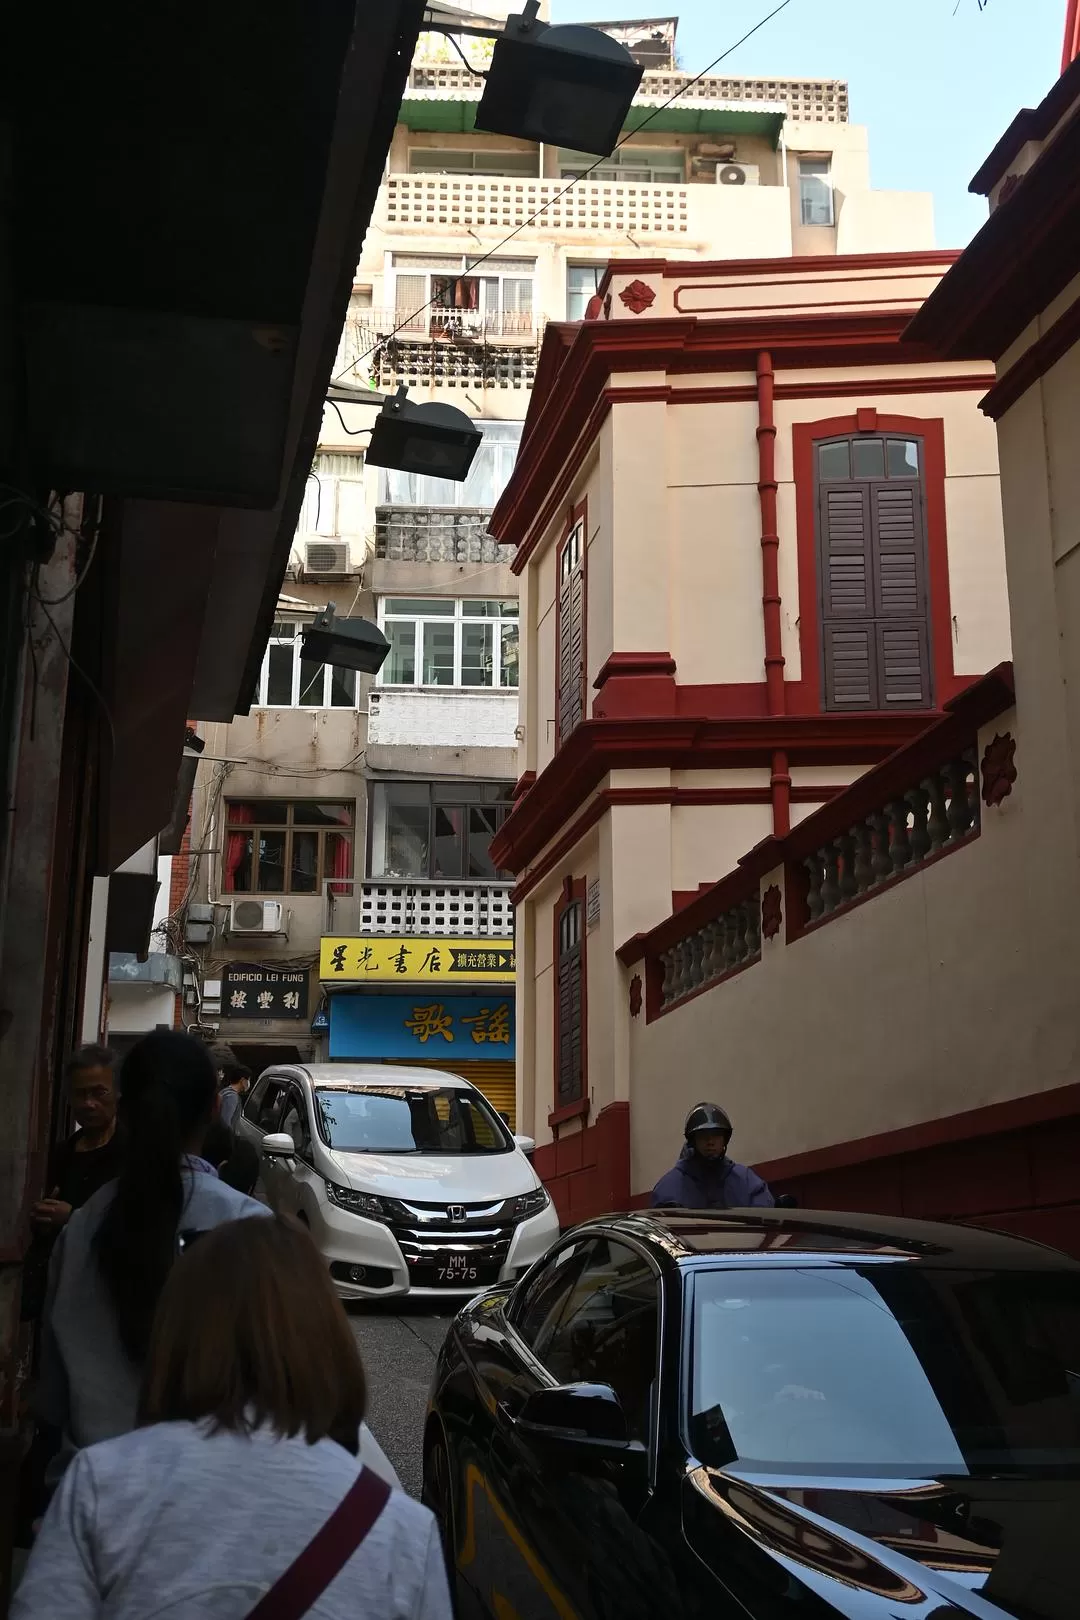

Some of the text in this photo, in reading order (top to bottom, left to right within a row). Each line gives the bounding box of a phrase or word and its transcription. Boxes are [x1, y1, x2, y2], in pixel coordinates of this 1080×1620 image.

[329, 944, 441, 974] 星光書店
[228, 973, 304, 983] EDIFICIO LEI FUNG
[449, 1255, 467, 1268] MM
[437, 1267, 477, 1280] 75-75
